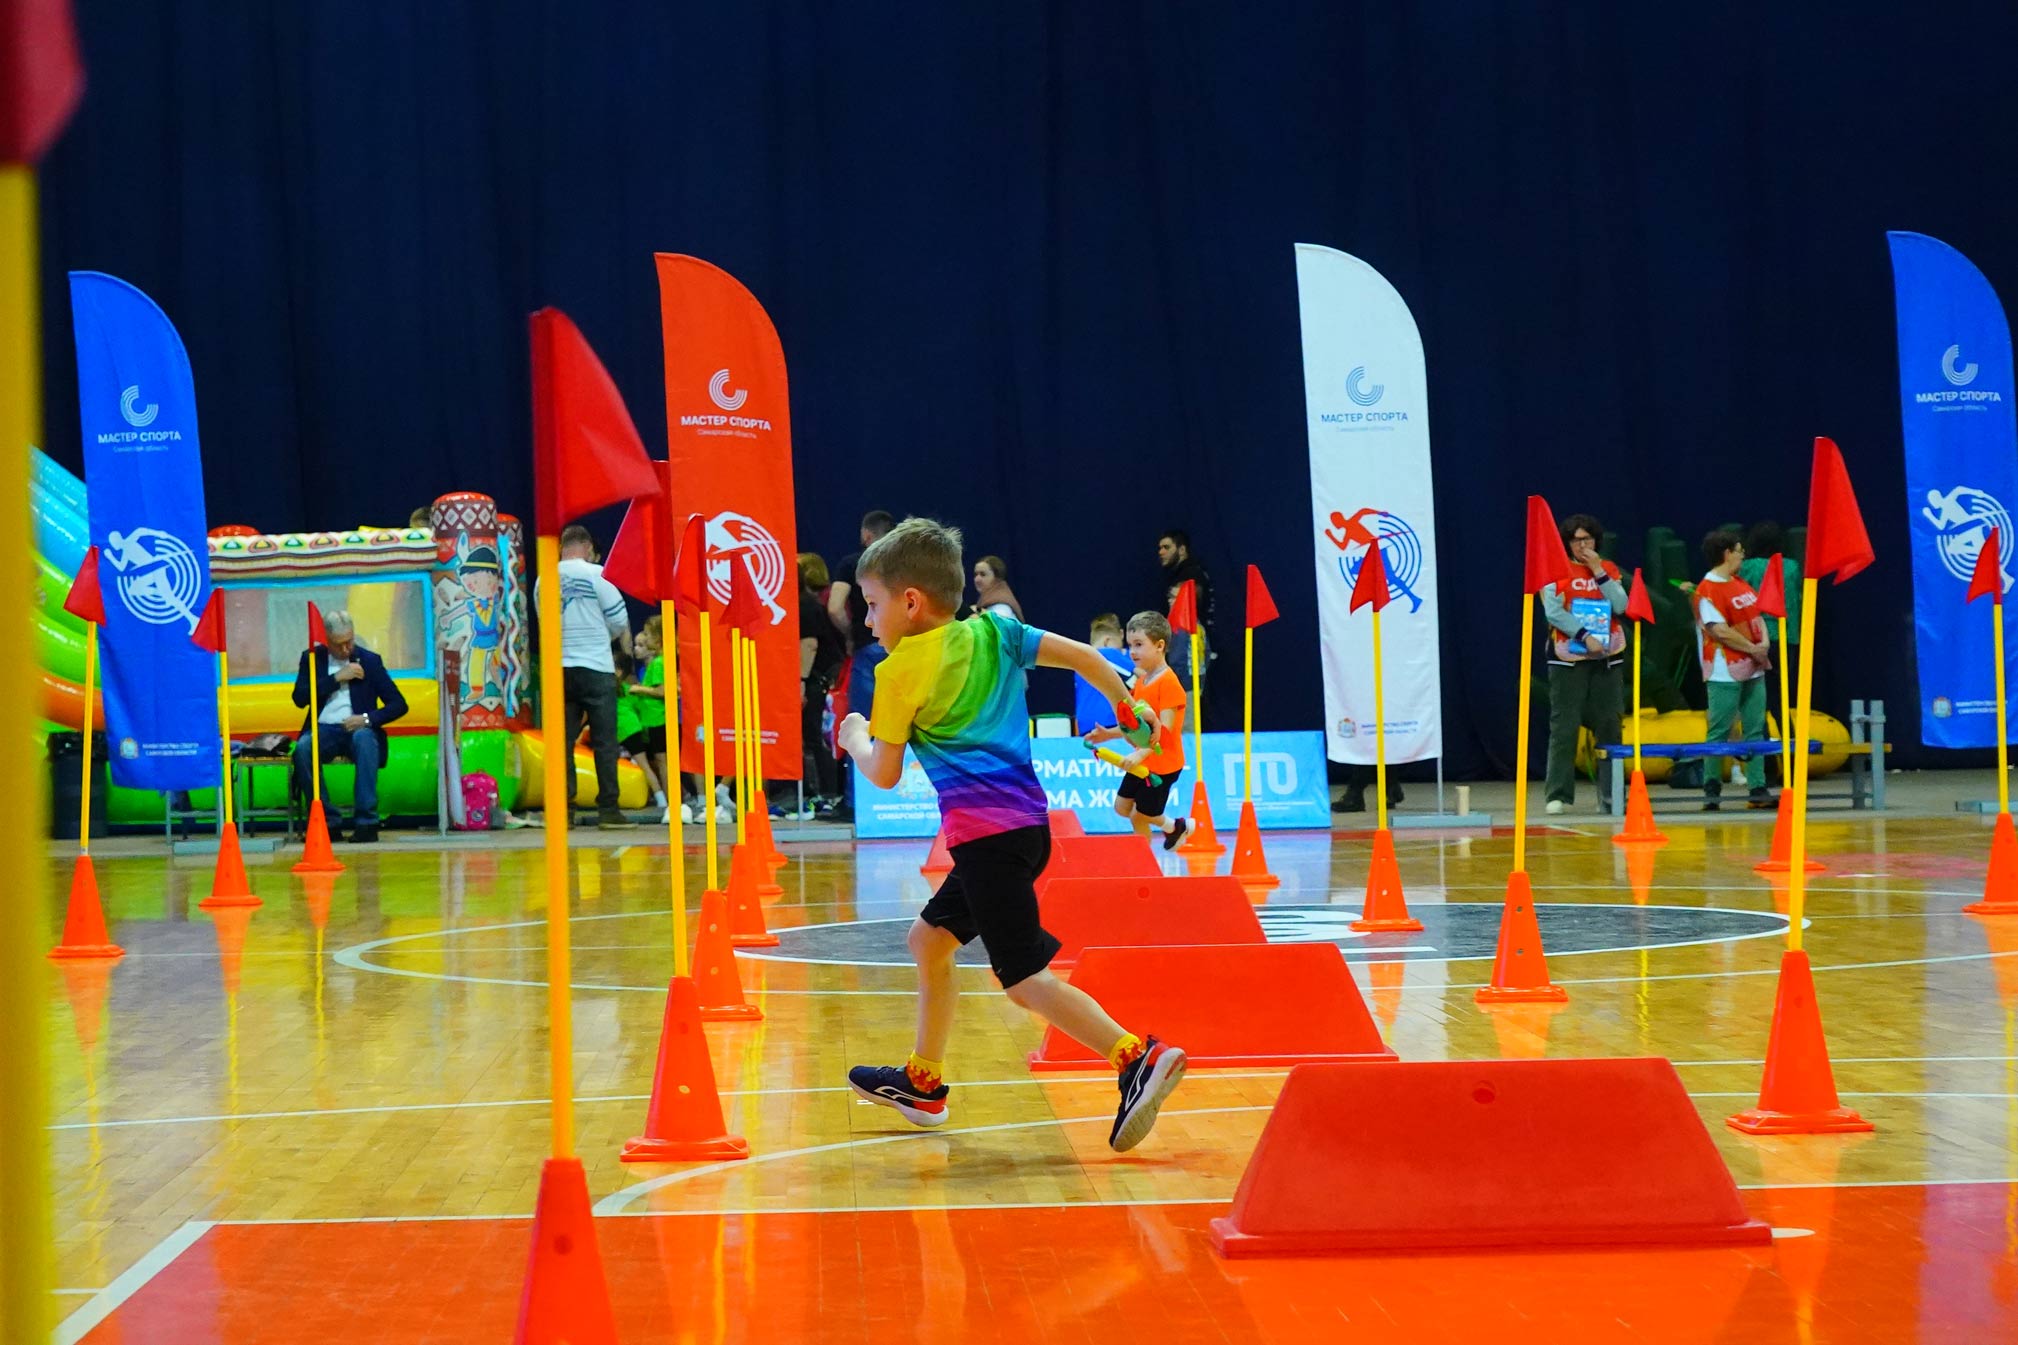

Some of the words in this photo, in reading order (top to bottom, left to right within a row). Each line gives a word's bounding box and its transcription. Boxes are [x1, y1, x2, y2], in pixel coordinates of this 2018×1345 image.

[1916, 392, 1958, 403] МАСТЕР
[1960, 391, 2001, 402] СПОРТА
[681, 415, 727, 426] МАСТЕР
[729, 416, 772, 431] СПОРТА
[1321, 413, 1363, 423] МАСТЕР
[1366, 412, 1408, 422] СПОРТА
[98, 432, 137, 444] МАСТЕР
[140, 431, 182, 442] СПОРТА
